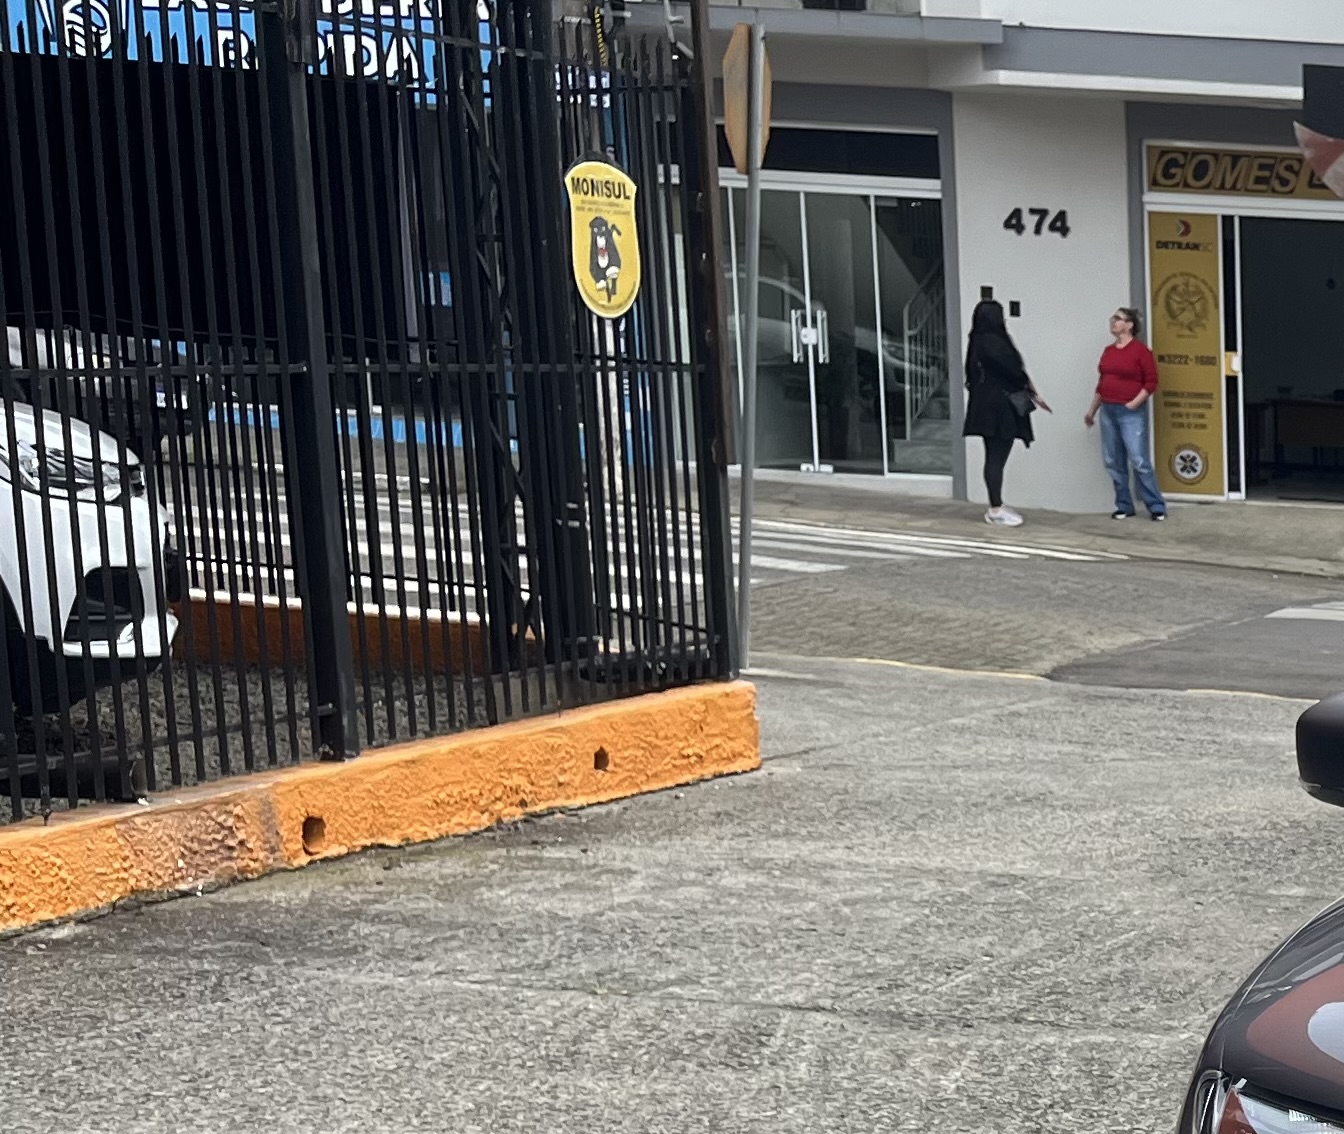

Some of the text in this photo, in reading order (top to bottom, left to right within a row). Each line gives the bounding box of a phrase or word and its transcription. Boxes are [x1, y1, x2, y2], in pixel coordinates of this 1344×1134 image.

[571, 176, 631, 201] MONISUL
[1154, 152, 1299, 194] GOMES
[1003, 208, 1071, 239] 474
